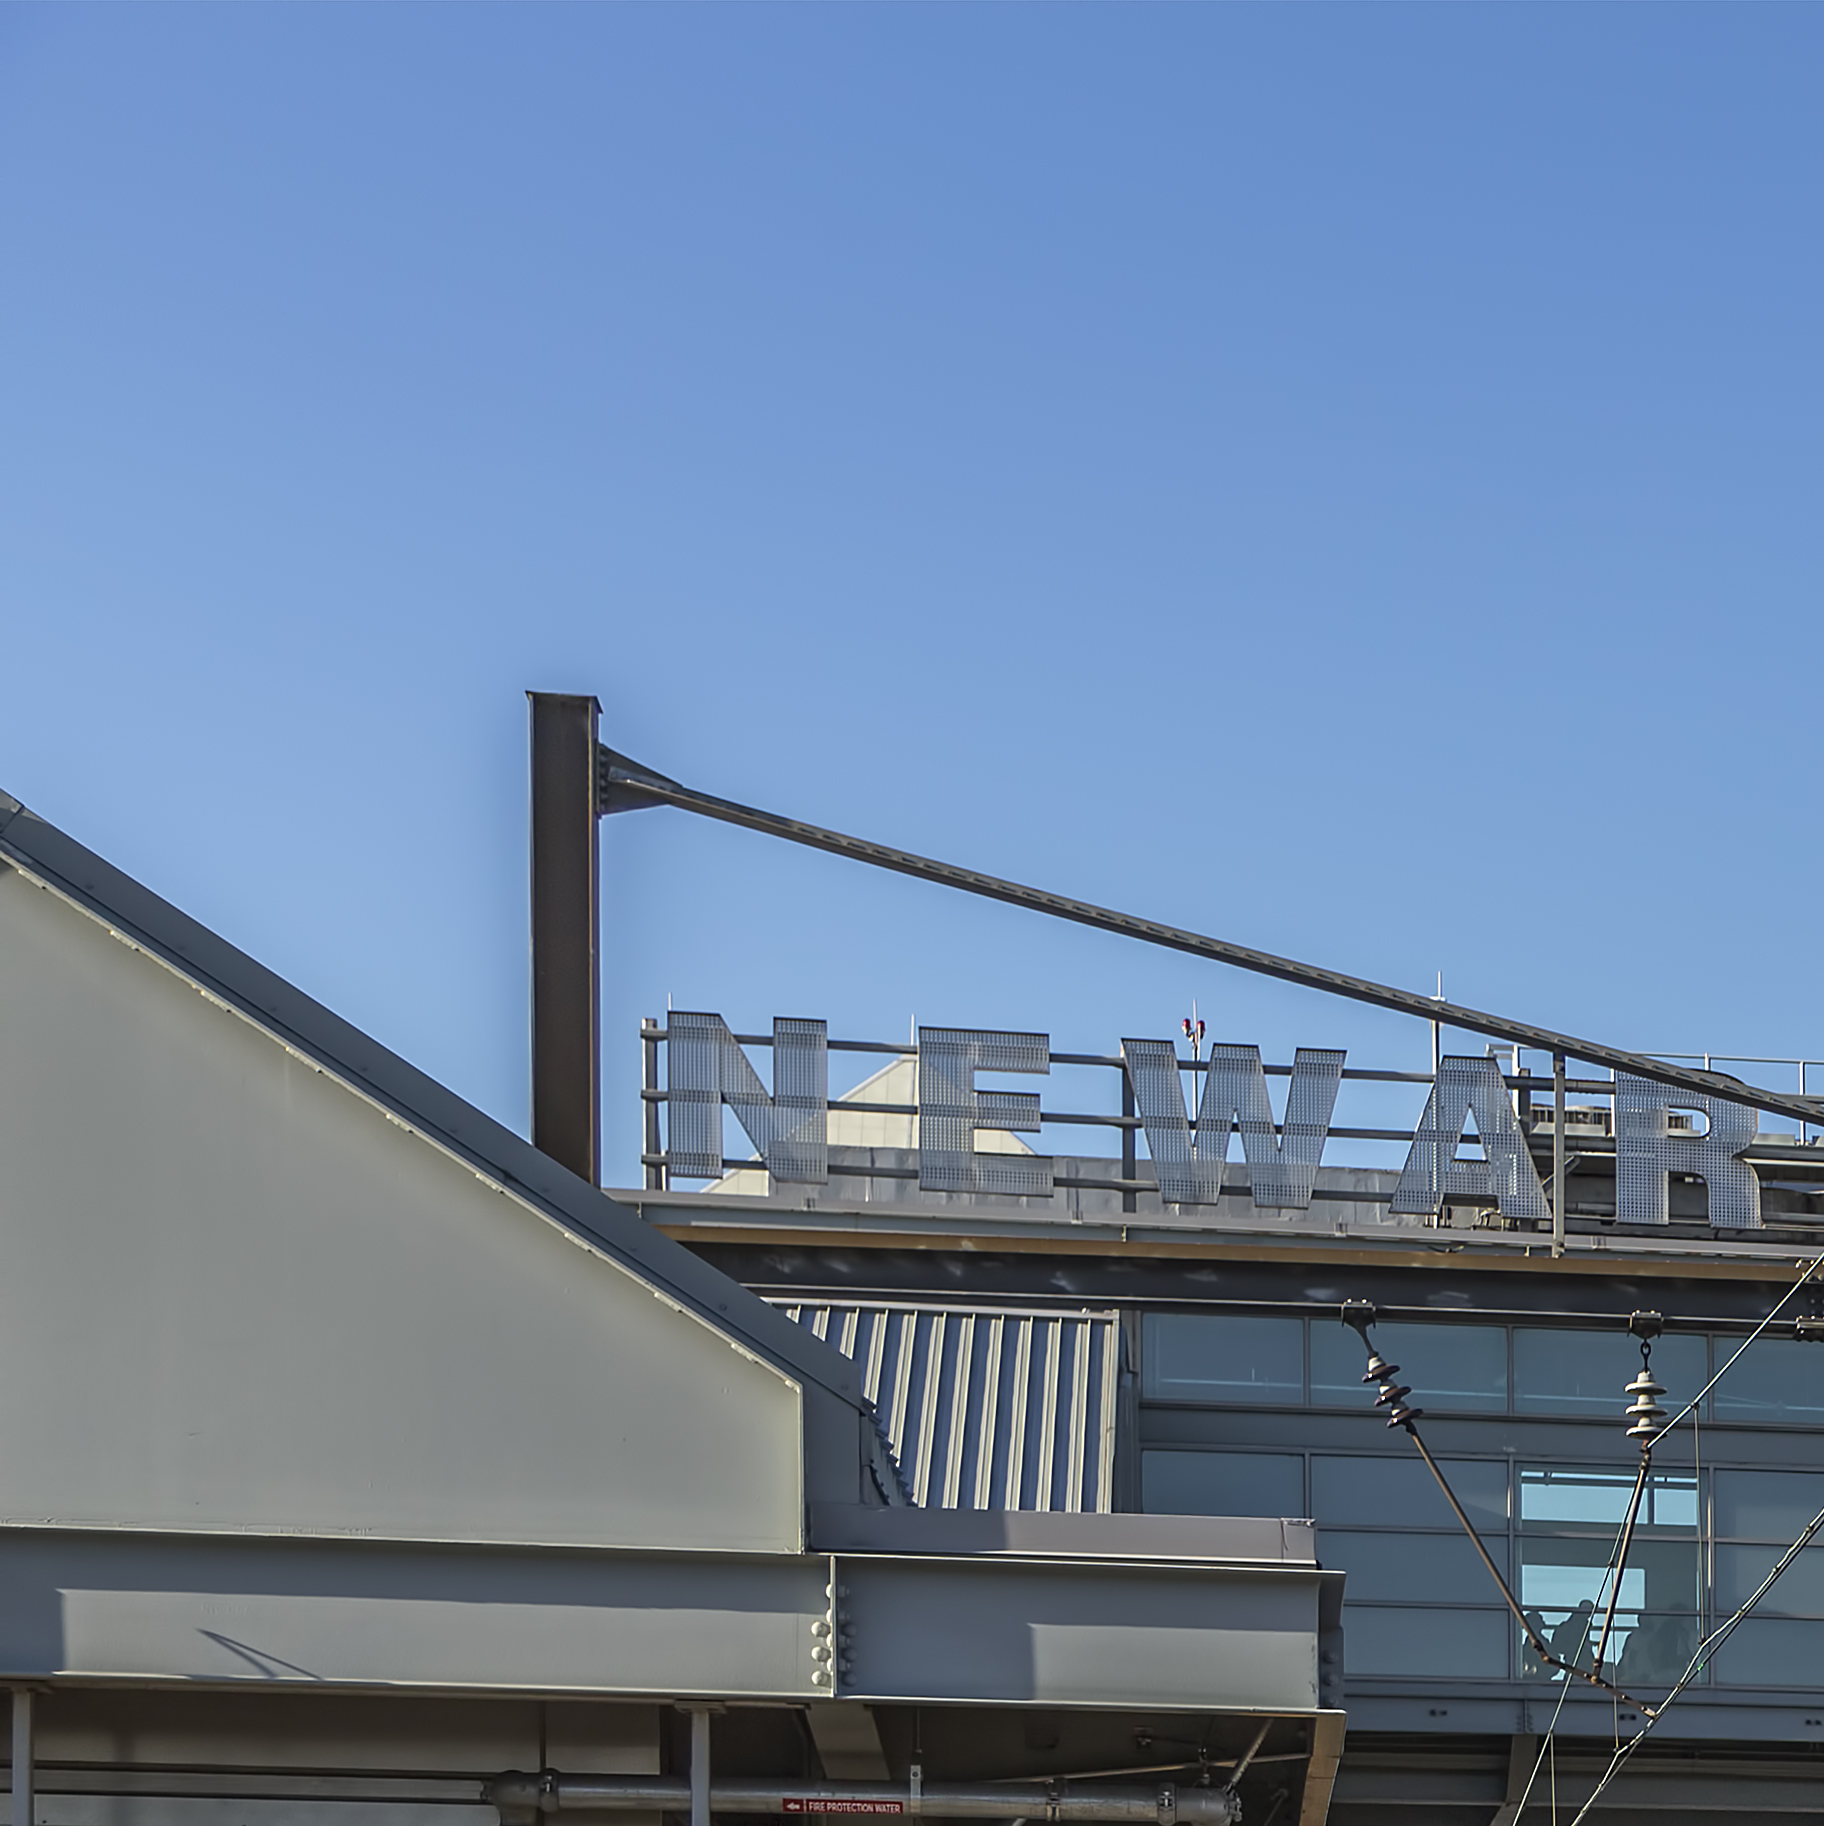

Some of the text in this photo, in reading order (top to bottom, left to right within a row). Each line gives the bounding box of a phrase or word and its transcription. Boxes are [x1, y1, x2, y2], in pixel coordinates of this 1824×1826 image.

[809, 1801, 901, 1814] FIRE PROTECTION WATER
